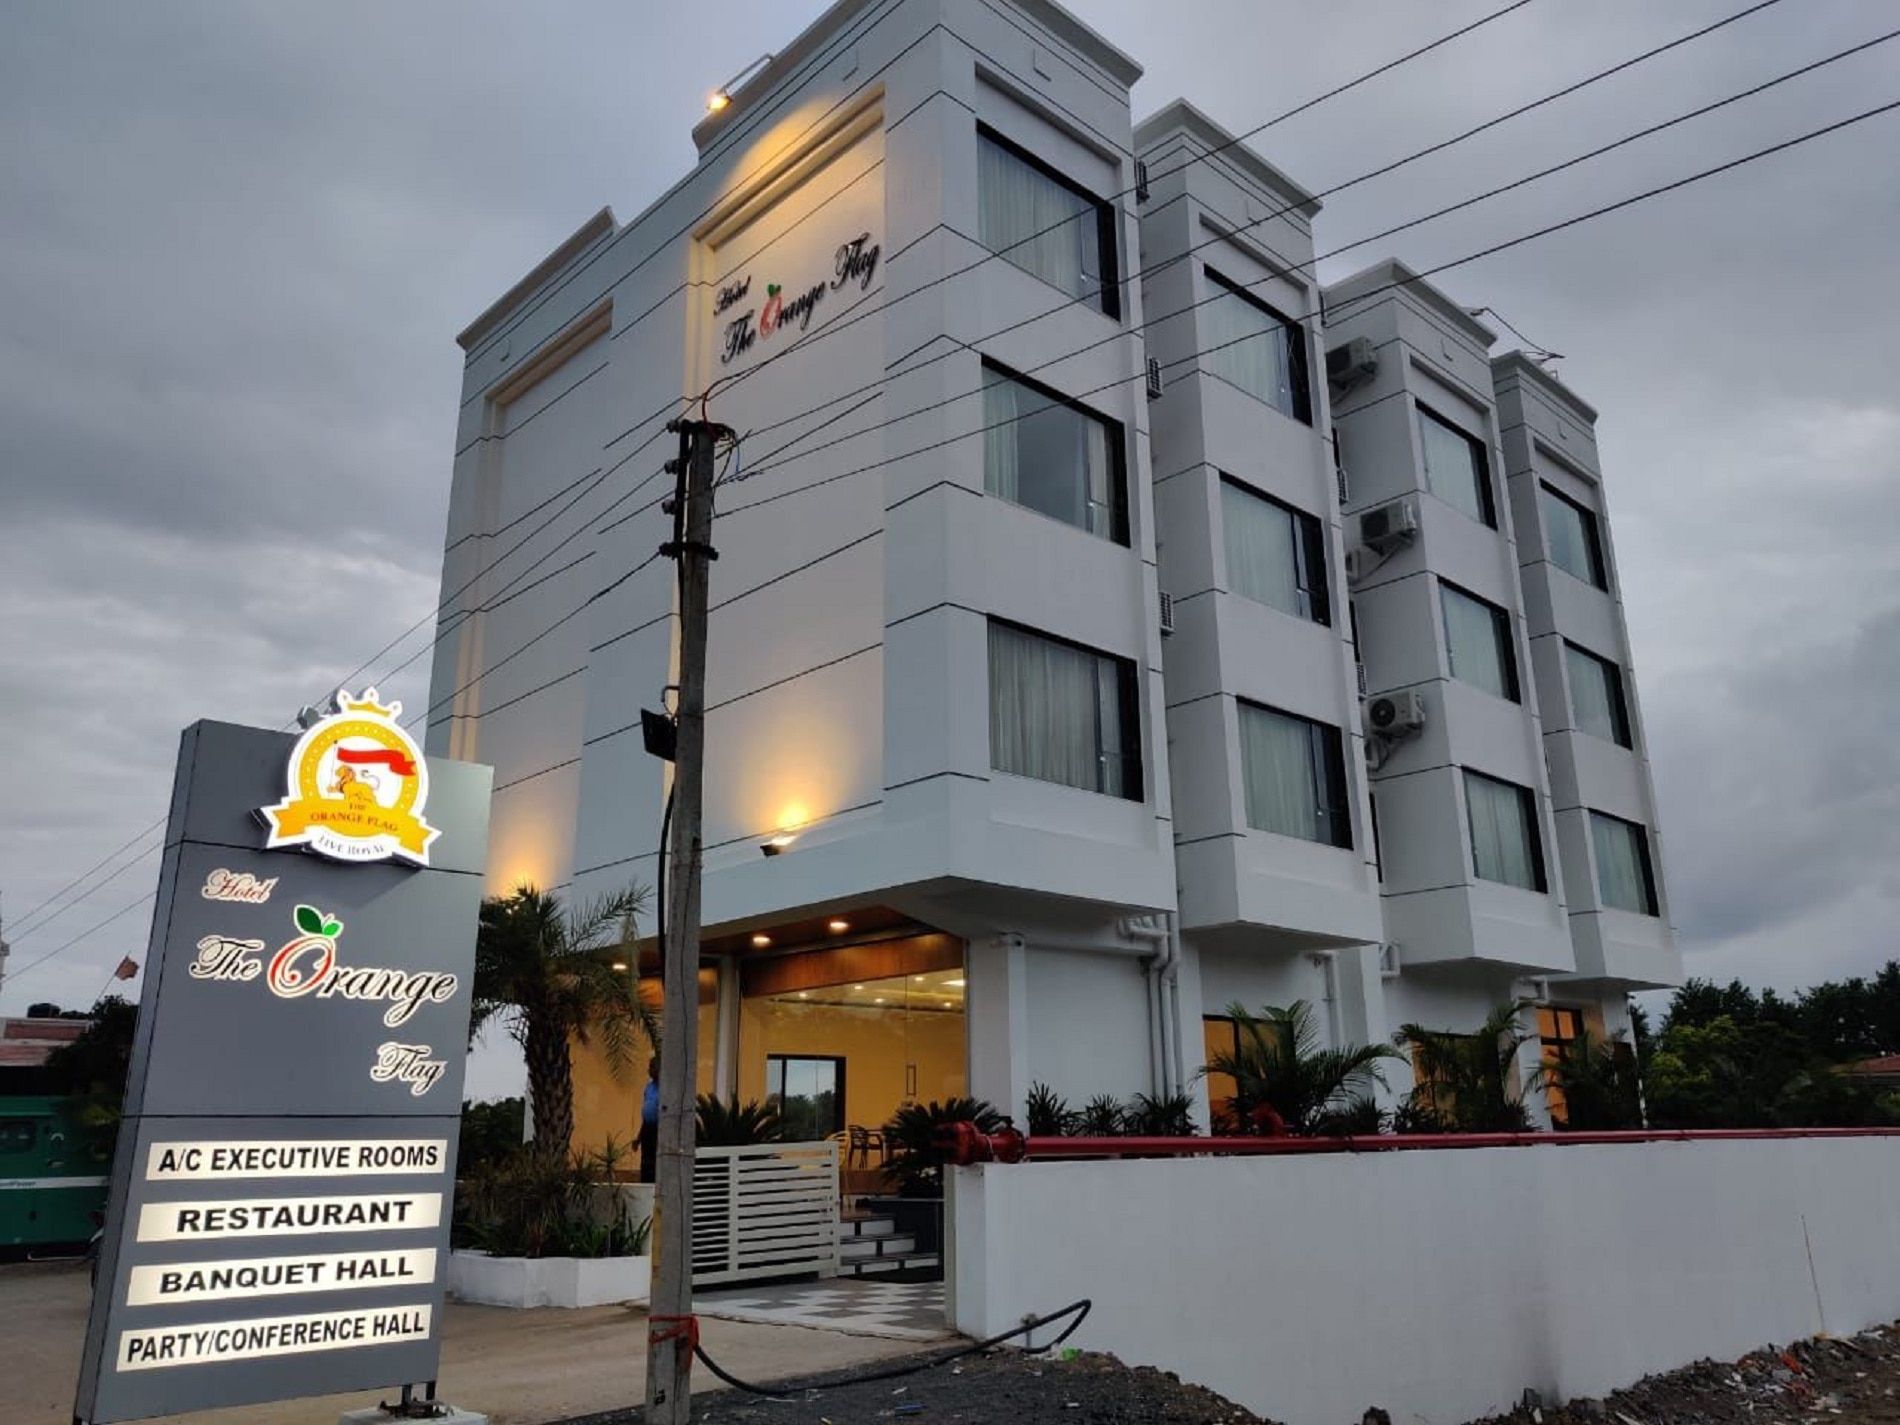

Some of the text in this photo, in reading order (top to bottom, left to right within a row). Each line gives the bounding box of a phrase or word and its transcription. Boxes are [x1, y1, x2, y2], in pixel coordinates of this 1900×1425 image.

[721, 232, 880, 363] The Orange Flag
[310, 811, 399, 832] ORANGE FLAG
[318, 835, 345, 853] LIVE
[202, 869, 279, 903] Hotel
[189, 935, 458, 1028] The Orange
[370, 1042, 446, 1096] Flag
[158, 1145, 438, 1172] A/C EXECUTIVE ROOMS
[176, 1201, 413, 1233] RESTAURANT
[159, 1257, 414, 1294] BANQUET HALL
[127, 1312, 425, 1363] PARTY/CONFERENCE HALL
